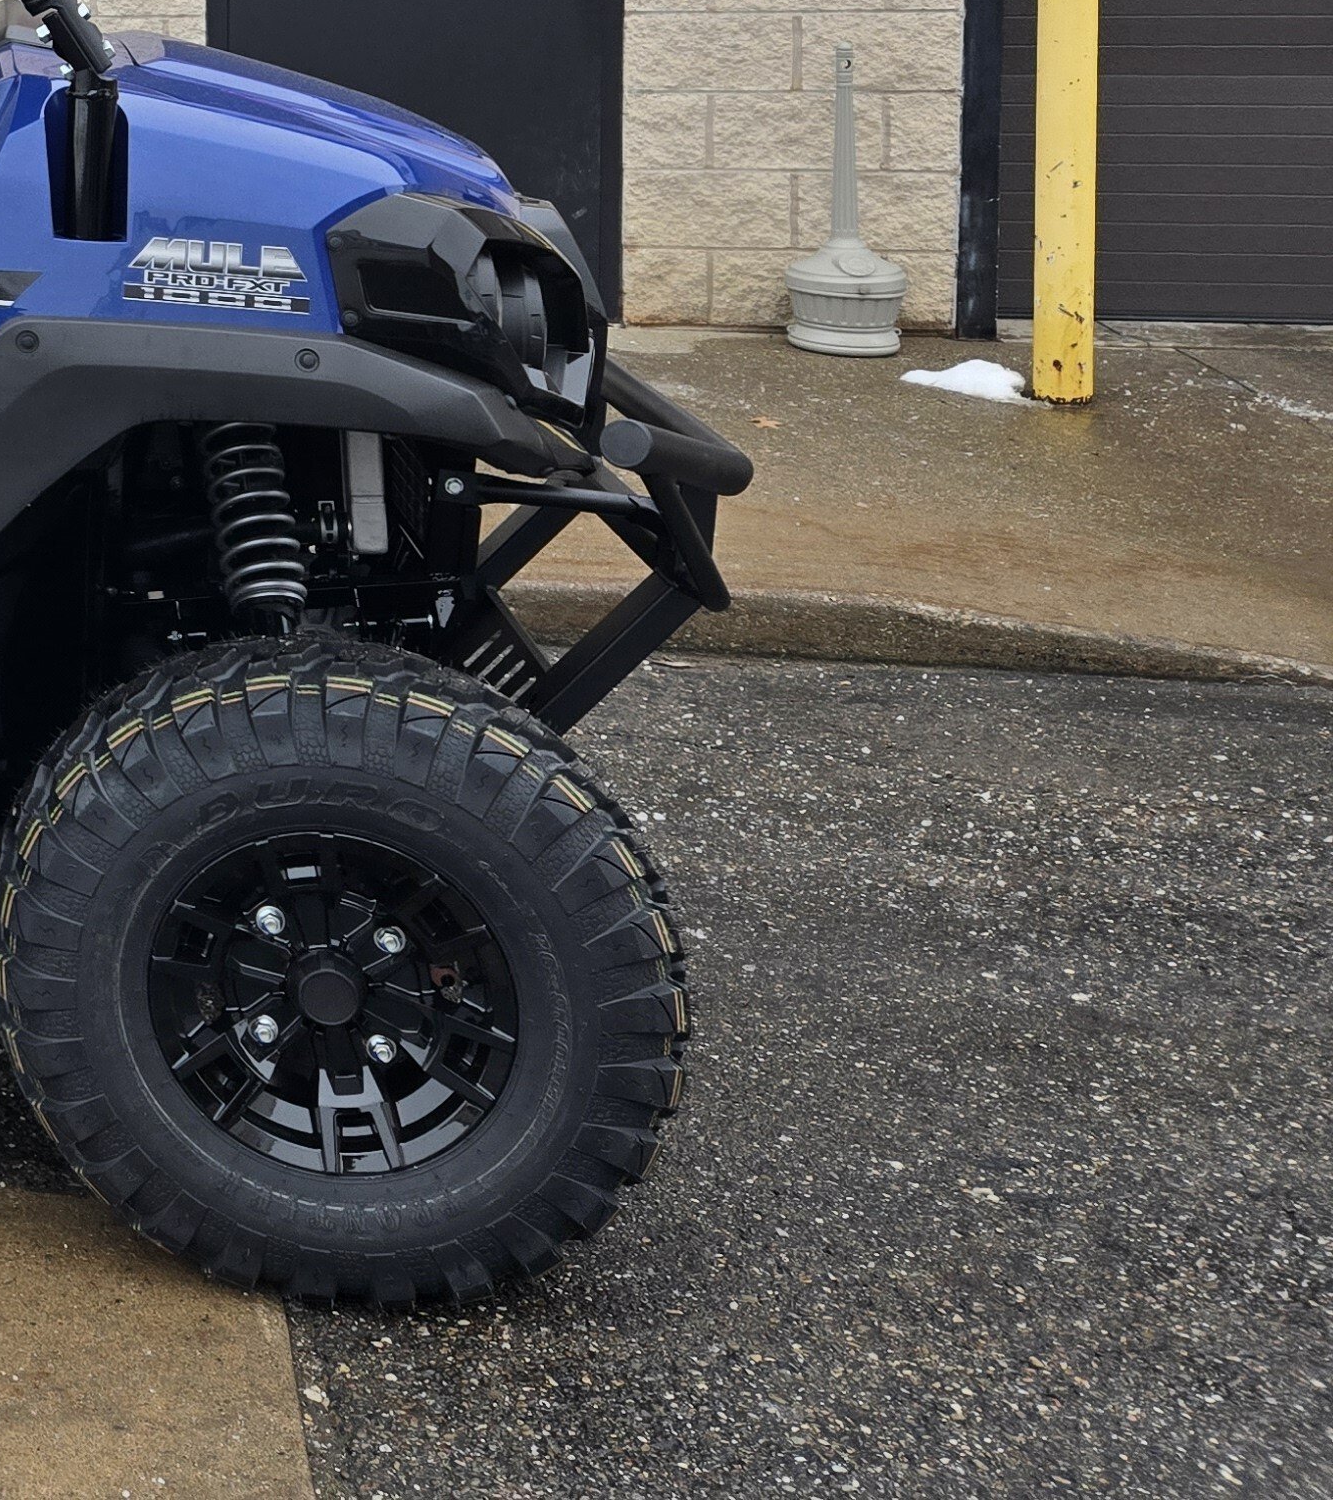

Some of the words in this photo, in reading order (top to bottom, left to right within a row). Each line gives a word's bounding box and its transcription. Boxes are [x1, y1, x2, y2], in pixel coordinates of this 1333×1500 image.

[128, 237, 308, 282] MULE
[141, 286, 292, 311] 1000
[198, 775, 445, 834] DURO
